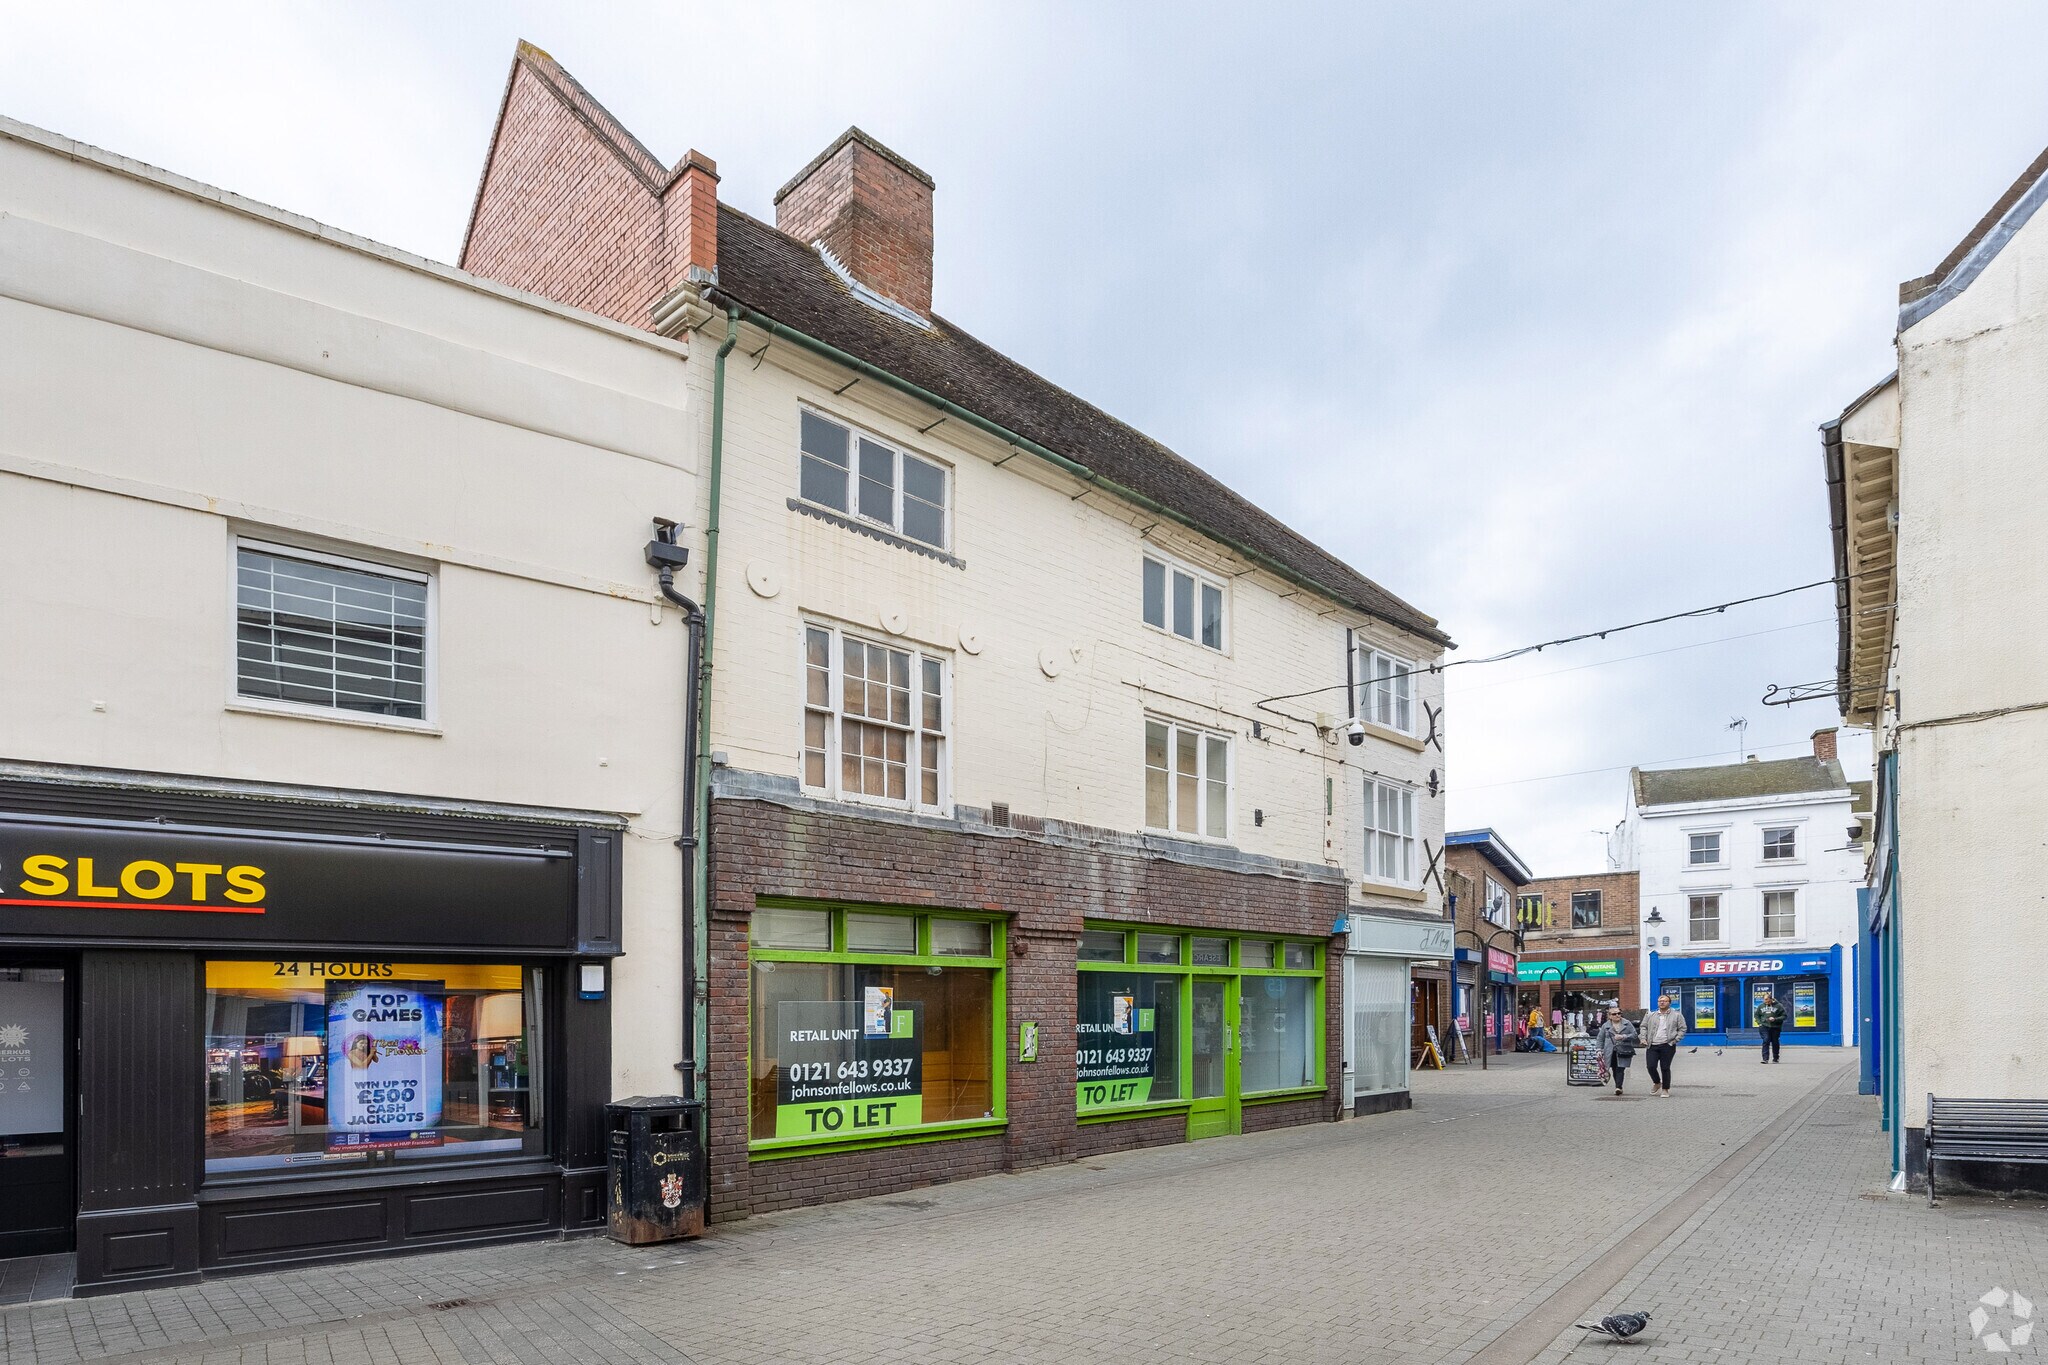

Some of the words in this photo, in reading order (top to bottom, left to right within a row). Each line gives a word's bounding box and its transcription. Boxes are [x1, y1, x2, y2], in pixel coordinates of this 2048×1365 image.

[19, 854, 266, 904] SLOTS
[274, 962, 299, 976] 24
[309, 962, 393, 977] HOURS
[1703, 959, 1784, 973] BETFRED
[367, 994, 409, 1007] TOP
[352, 1008, 423, 1022] GAMES
[896, 1015, 905, 1033] F
[1076, 1023, 1102, 1033] RETAIL
[790, 1030, 829, 1042] RETAIL
[831, 1029, 860, 1041] UNIT
[1076, 1050, 1102, 1065] 0121
[1106, 1048, 1126, 1063] 643
[1128, 1047, 1153, 1062] 9337
[790, 1062, 831, 1082] 0121
[837, 1060, 868, 1079] 643
[873, 1058, 913, 1077] 9337
[1076, 1064, 1149, 1079] johnsonfellows.co.uk
[354, 1081, 380, 1090] WIN
[383, 1080, 399, 1089] UP
[401, 1079, 418, 1088] TO
[791, 1077, 911, 1101] johnsonfellows.co.uk
[357, 1087, 415, 1104] £500
[1083, 1085, 1107, 1105] TO
[1110, 1082, 1138, 1102] LET
[366, 1102, 406, 1115] CASH
[347, 1112, 424, 1126] JACKPOTS
[805, 1106, 844, 1132] TO
[853, 1102, 897, 1128] LET
